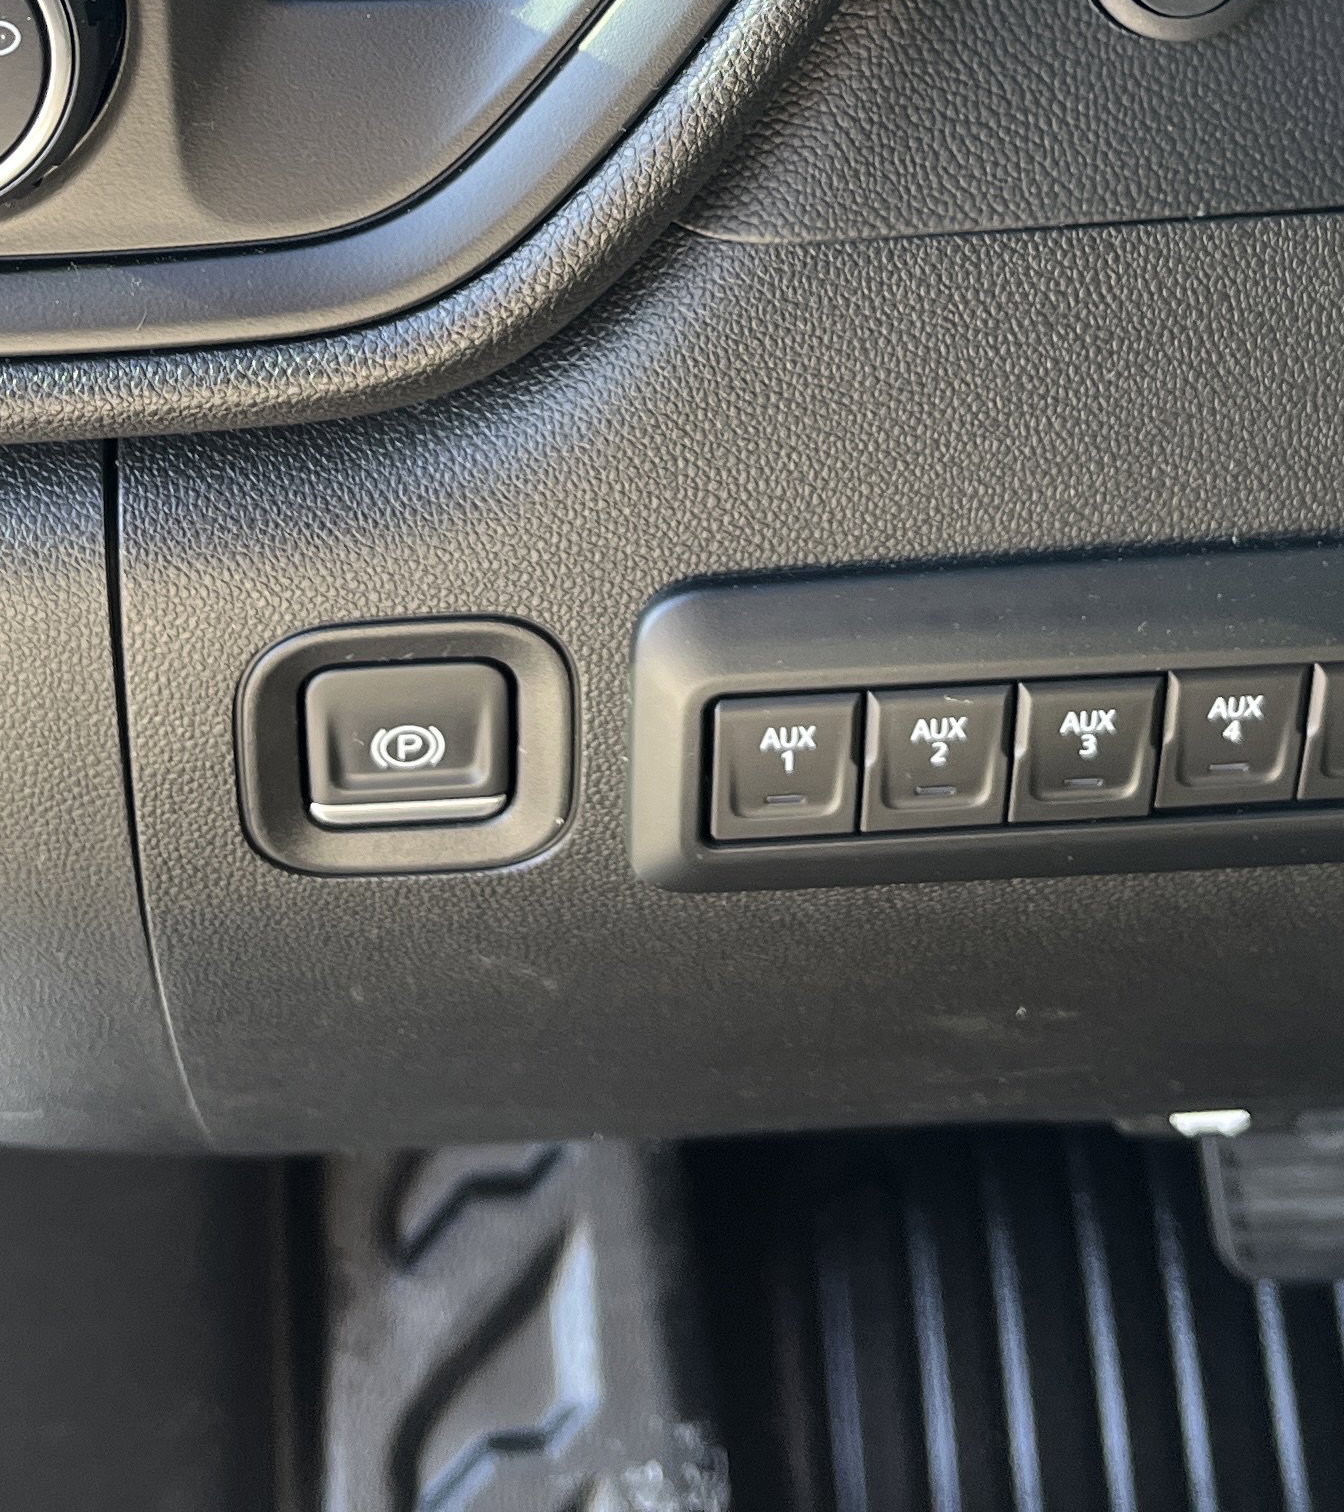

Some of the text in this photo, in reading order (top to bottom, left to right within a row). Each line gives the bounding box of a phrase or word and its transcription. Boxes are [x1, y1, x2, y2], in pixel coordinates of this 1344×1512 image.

[1207, 695, 1265, 721] AUX
[910, 716, 968, 742] AUX
[1060, 709, 1117, 735] AUX
[1221, 720, 1243, 744] 4
[760, 726, 817, 751] AUX
[1078, 734, 1099, 760] 3
[781, 751, 795, 774] 1
[930, 742, 949, 767] 2
